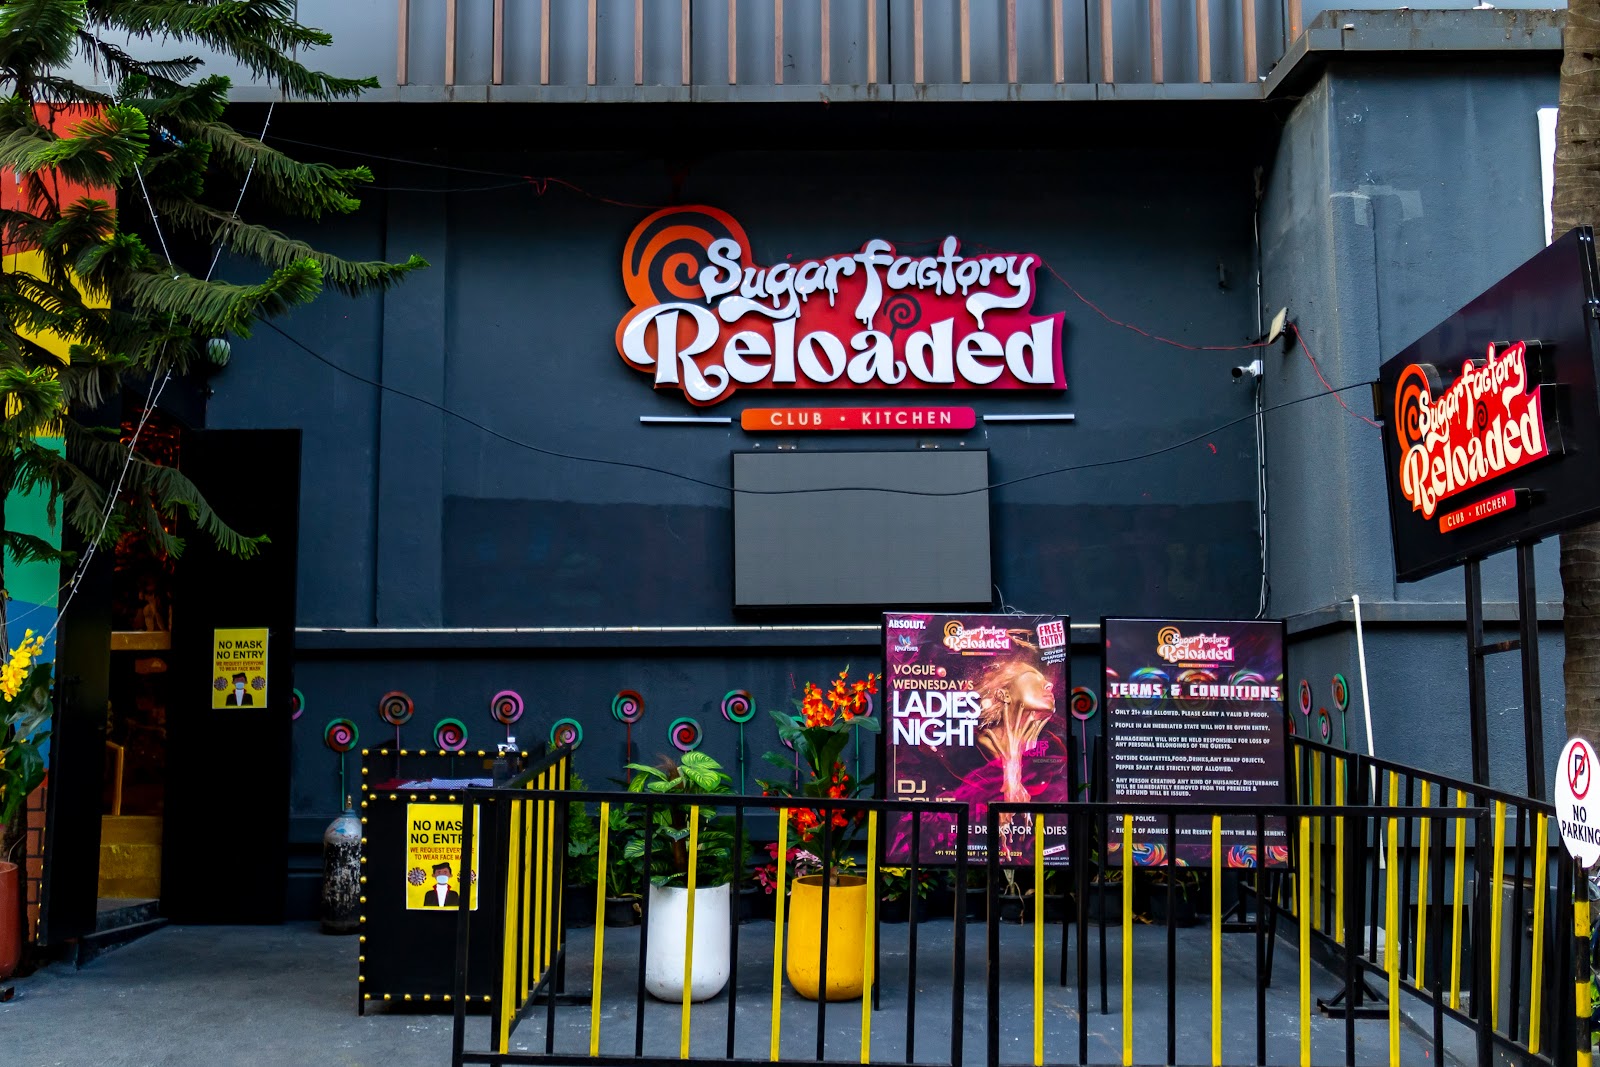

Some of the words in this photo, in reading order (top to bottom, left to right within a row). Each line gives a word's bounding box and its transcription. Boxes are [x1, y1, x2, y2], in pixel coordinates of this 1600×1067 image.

[700, 239, 855, 322] Sugar
[623, 303, 1055, 401] Reloaded
[771, 412, 822, 426] CLUB
[862, 412, 952, 426] KITCHEN
[1419, 386, 1464, 452] Sugar
[1404, 396, 1542, 515] Reloaded
[1447, 513, 1464, 527] CLUB
[1475, 496, 1507, 517] KITCHEN
[888, 620, 926, 629] ABSOLUT.
[1039, 622, 1063, 636] FREE
[218, 641, 232, 649] NO
[944, 636, 1010, 651] Reloaded
[1040, 633, 1063, 646] ENTRY
[217, 651, 230, 659] NO
[234, 651, 264, 659] ENTRY
[1159, 644, 1233, 663] Reloaded
[893, 664, 936, 675] VOGUE
[893, 679, 974, 690] WEDNESDAY'S
[1111, 683, 1162, 696] TERMS
[1170, 684, 1182, 697] &
[1190, 684, 1280, 698] CONDITIONS
[893, 690, 981, 718] LADIES
[893, 718, 979, 747] NIGHT
[897, 780, 927, 793] DJ
[1572, 804, 1586, 823] NO
[413, 821, 431, 830] NO
[436, 821, 463, 830] MAS
[974, 825, 1009, 834] DRKS
[1012, 826, 1032, 834] FOR
[411, 834, 429, 843] NO
[1562, 820, 1600, 846] PARKING
